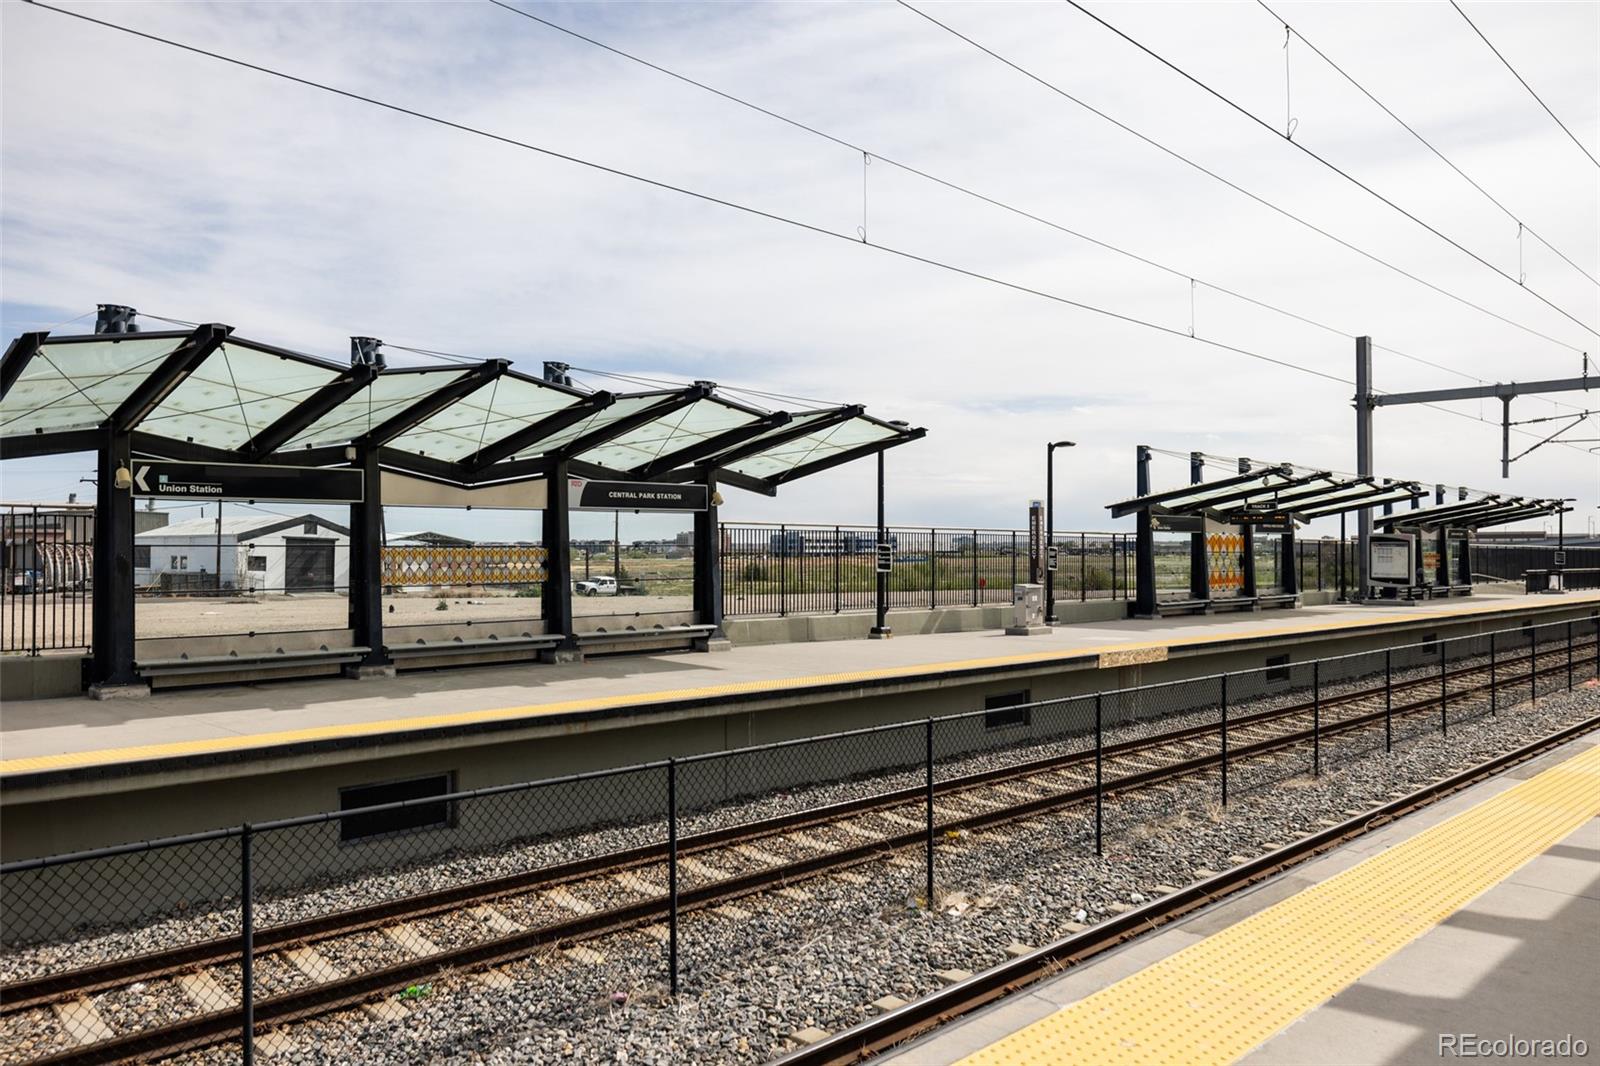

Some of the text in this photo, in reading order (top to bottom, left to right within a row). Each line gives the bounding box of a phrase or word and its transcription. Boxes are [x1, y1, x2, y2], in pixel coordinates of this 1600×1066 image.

[159, 484, 223, 493] Union Station
[608, 491, 637, 499] CENTRAL
